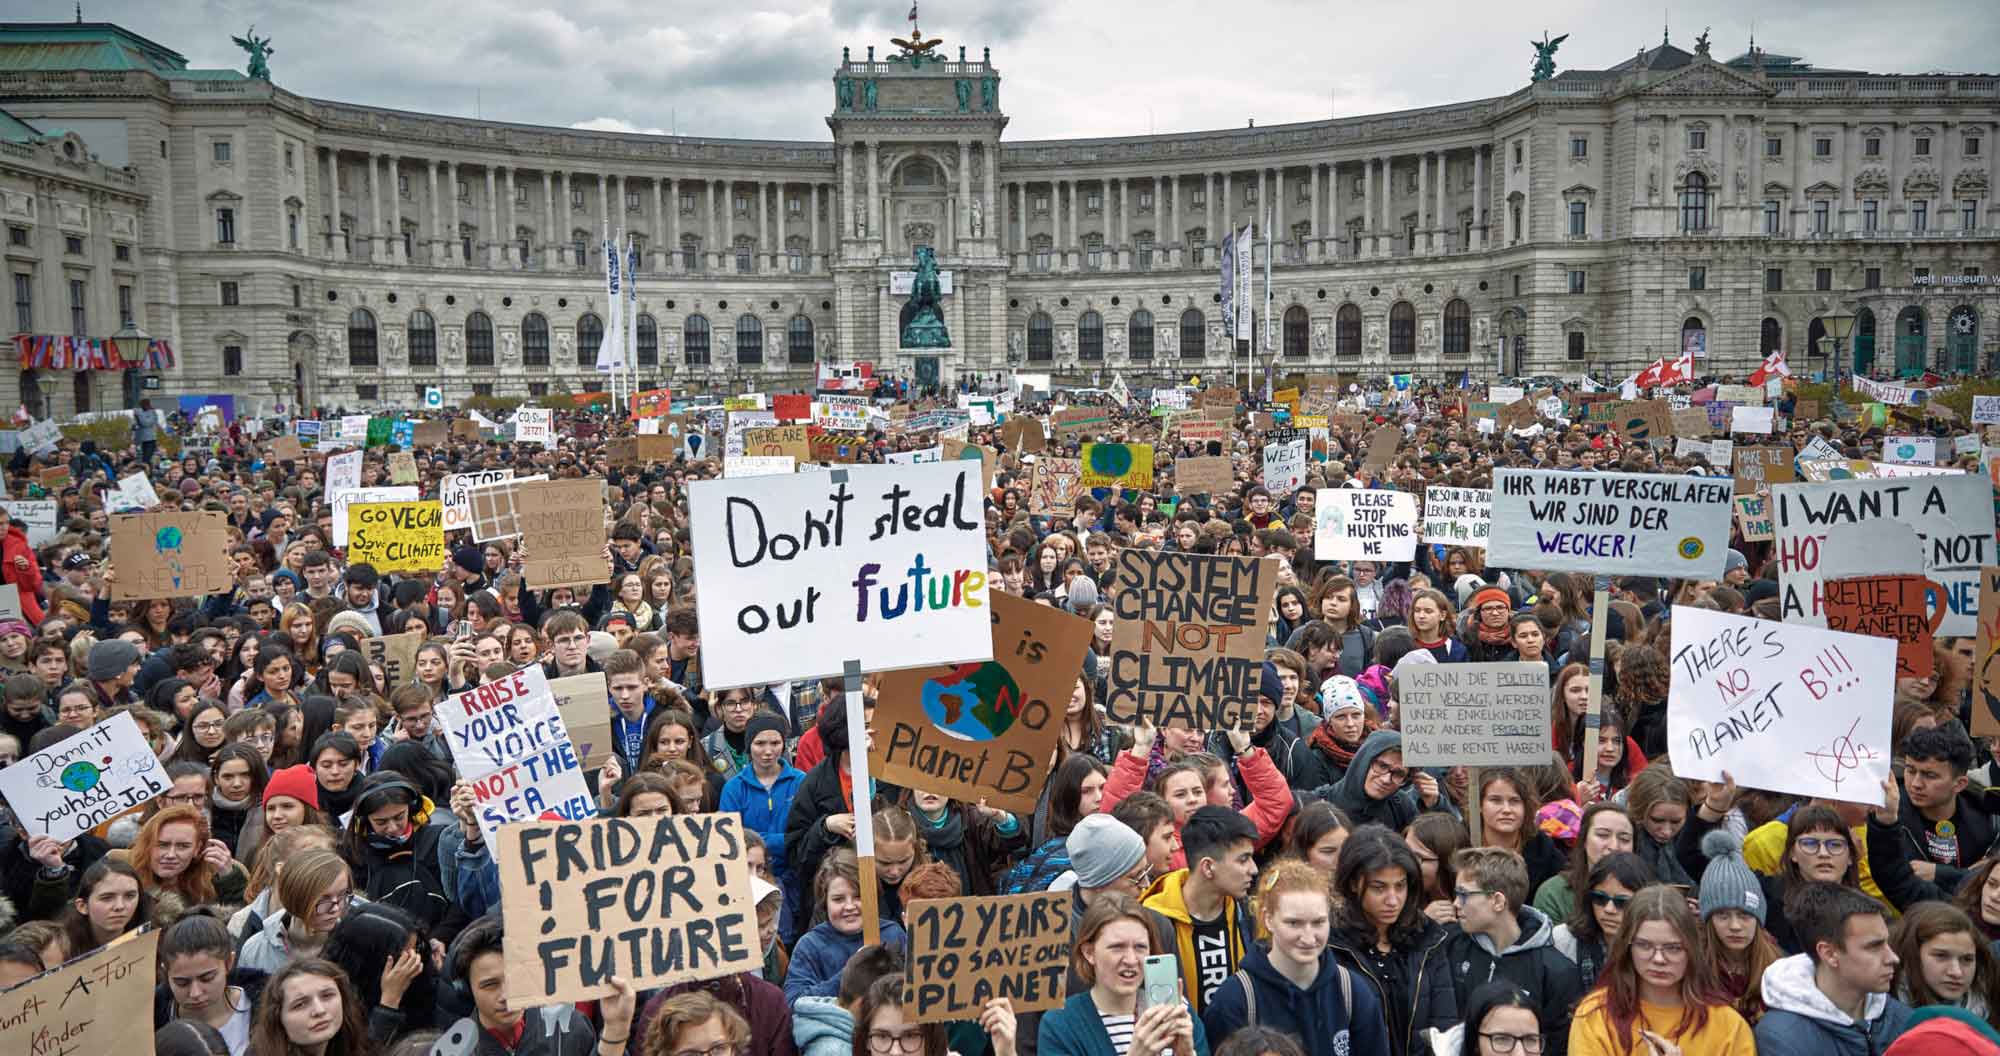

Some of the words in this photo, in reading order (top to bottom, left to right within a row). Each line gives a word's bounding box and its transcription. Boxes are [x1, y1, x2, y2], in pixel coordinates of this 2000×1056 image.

[1913, 272, 1935, 285] welt
[1941, 275, 1984, 285] museum
[748, 428, 779, 446] THERE
[782, 429, 802, 442] ARE
[1265, 445, 1303, 463] WELT
[1351, 493, 1394, 508] PLEASE
[1503, 475, 1535, 496] IHR
[1544, 477, 1597, 497] HABT
[1601, 478, 1731, 504] VERSCHLAFEN
[1779, 493, 1789, 528] I
[1799, 486, 1911, 525] WANT
[1922, 486, 1947, 515] A
[360, 508, 388, 524] GO
[390, 506, 442, 530] VEGAN
[726, 482, 854, 568] Don't
[1347, 523, 1409, 539] HURTING
[1353, 508, 1387, 524] STOP
[1425, 521, 1449, 537] NICHT
[1529, 500, 1567, 524] WIR
[1573, 503, 1620, 526] SIND
[1629, 507, 1669, 531] DER
[386, 542, 442, 561] CLIMATE
[1363, 541, 1382, 555] ME
[1536, 531, 1636, 559] WECKER!
[1781, 534, 1827, 574] HO
[1933, 533, 1993, 565] NOT
[547, 564, 581, 582] IKEA
[1119, 549, 1260, 599] SYSTEM
[737, 587, 821, 634] our
[1116, 587, 1257, 626] CHANGE
[1783, 583, 1804, 618] A
[1823, 578, 1918, 607] RETTET
[1015, 630, 1048, 664] is
[1141, 619, 1243, 654] NOT
[1673, 620, 1785, 685] THERE'S
[1112, 650, 1264, 697] CLIMATE
[1412, 671, 1459, 689] WENN
[1467, 671, 1488, 686] DIE
[1496, 671, 1545, 686] POLITIK
[1715, 667, 1750, 705] NO
[459, 670, 530, 717] RAISE
[1105, 687, 1259, 732] CHANGE
[1401, 692, 1433, 705] JETZT
[1496, 693, 1545, 705] WERDEN
[453, 703, 524, 748] YOUR
[1405, 724, 1436, 736] GANZ
[1441, 724, 1483, 736] ANDERE
[1491, 724, 1542, 736] PROBLEME
[1409, 708, 1449, 721] UNSERE
[1457, 708, 1543, 721] ENKELKINDER
[1683, 681, 1784, 760] PLANET
[482, 715, 567, 767] VOICE
[885, 722, 989, 788] Planet
[993, 750, 1035, 794] B
[1408, 741, 1430, 754] ALS
[1437, 742, 1457, 754] IHRE
[1462, 742, 1499, 754] RENTE
[1505, 742, 1545, 754] HABEN
[472, 765, 520, 804] NOT
[522, 742, 578, 782] THE
[482, 786, 545, 832] SEA
[519, 816, 740, 886] FRIDAYS
[583, 866, 703, 933] FOR
[917, 902, 968, 951] 12
[976, 897, 1069, 947] YEARS
[538, 913, 749, 997] FUTURE
[916, 953, 960, 981] TO
[969, 944, 1030, 973] SAVE
[1035, 943, 1070, 961] OUR
[917, 964, 1066, 1017] PLANET
[30, 1018, 95, 1056] Kinder
